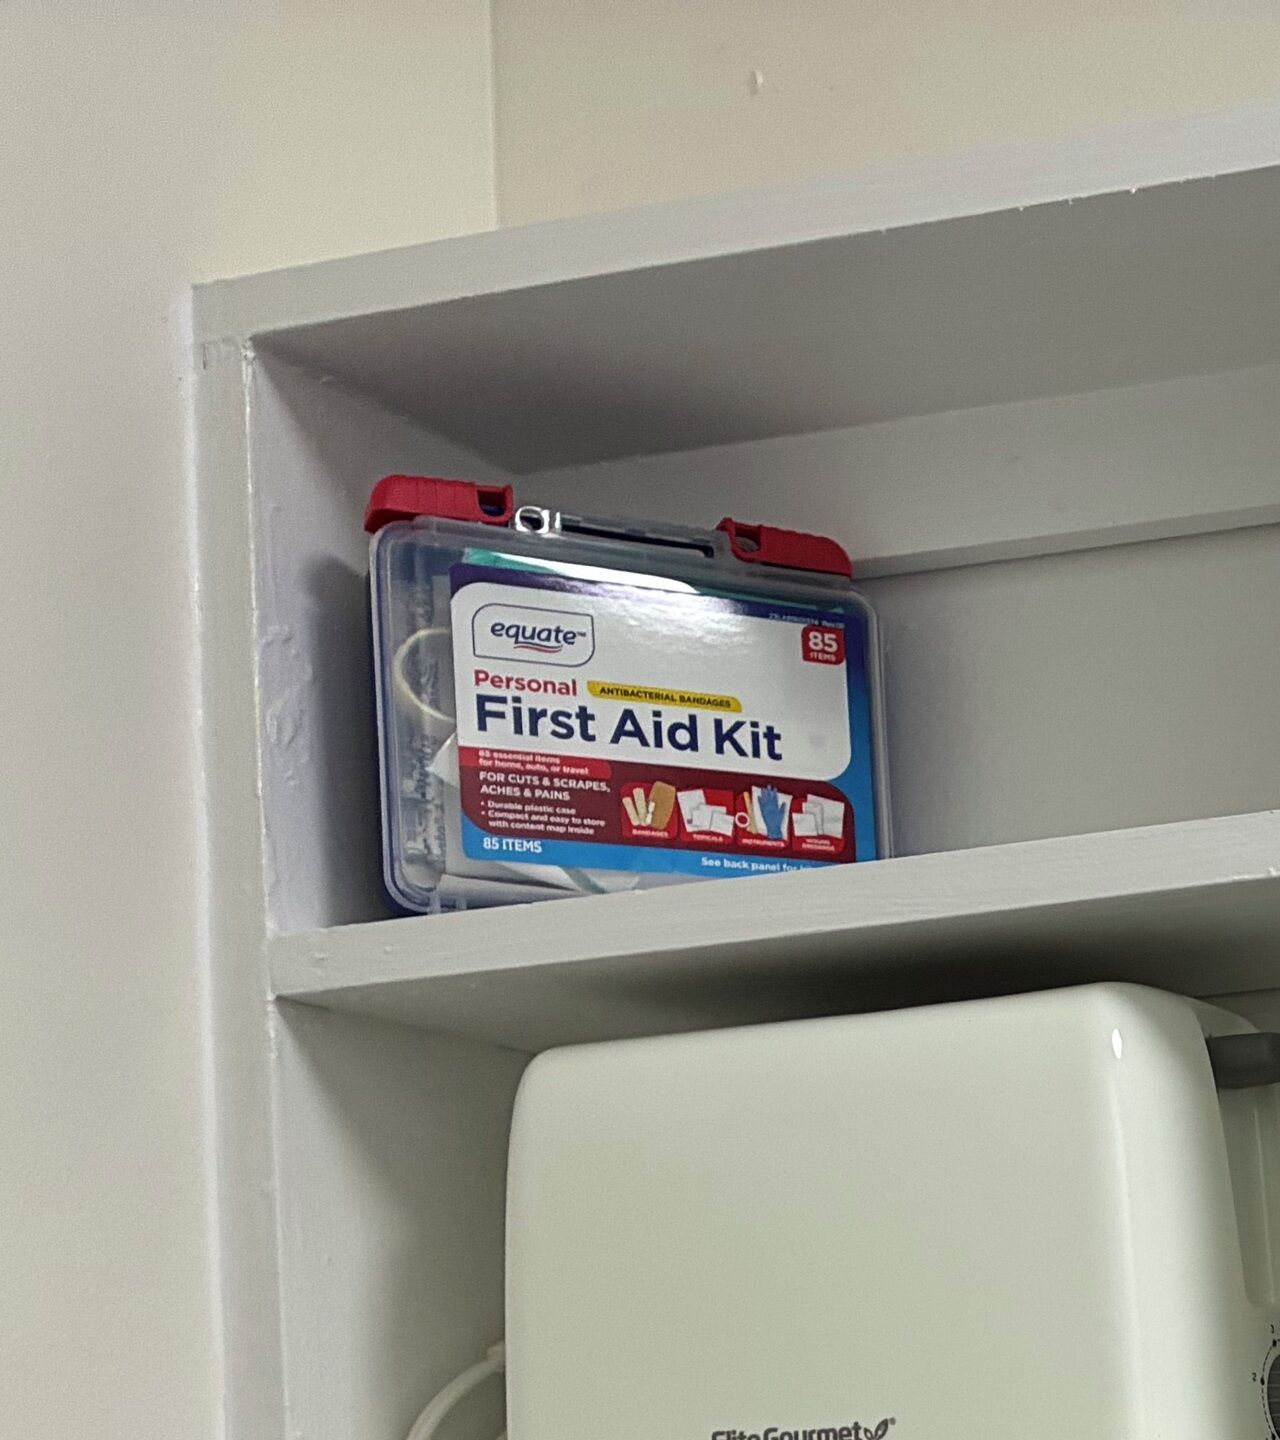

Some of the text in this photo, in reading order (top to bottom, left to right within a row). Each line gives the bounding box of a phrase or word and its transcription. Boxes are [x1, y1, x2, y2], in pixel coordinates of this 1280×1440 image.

[490, 622, 577, 645] equate
[809, 631, 838, 653] 85
[810, 652, 836, 662] ITEMS
[474, 669, 578, 696] Personal
[600, 686, 731, 709] ANTIBACTERIAL BANDAGES
[476, 693, 783, 761] First Aid Kit
[479, 758, 493, 767] for
[494, 759, 524, 771] home,
[525, 763, 549, 773] auto,
[563, 765, 589, 775] travel
[493, 752, 533, 762] essential
[534, 755, 560, 764] items
[479, 772, 611, 793] FOR CUTS & SCRAPES,
[480, 785, 570, 801] ACHES & PAINS
[487, 801, 576, 815] Durable plastic case
[488, 810, 529, 822] Compact
[530, 813, 548, 822] and
[550, 817, 569, 826] easy
[583, 818, 606, 826] store
[489, 819, 508, 827] with
[546, 826, 566, 834] map
[568, 825, 594, 835] inside
[483, 837, 542, 853] 85 ITEMS
[701, 856, 722, 868] See
[723, 858, 749, 870] back
[751, 861, 781, 873] panel
